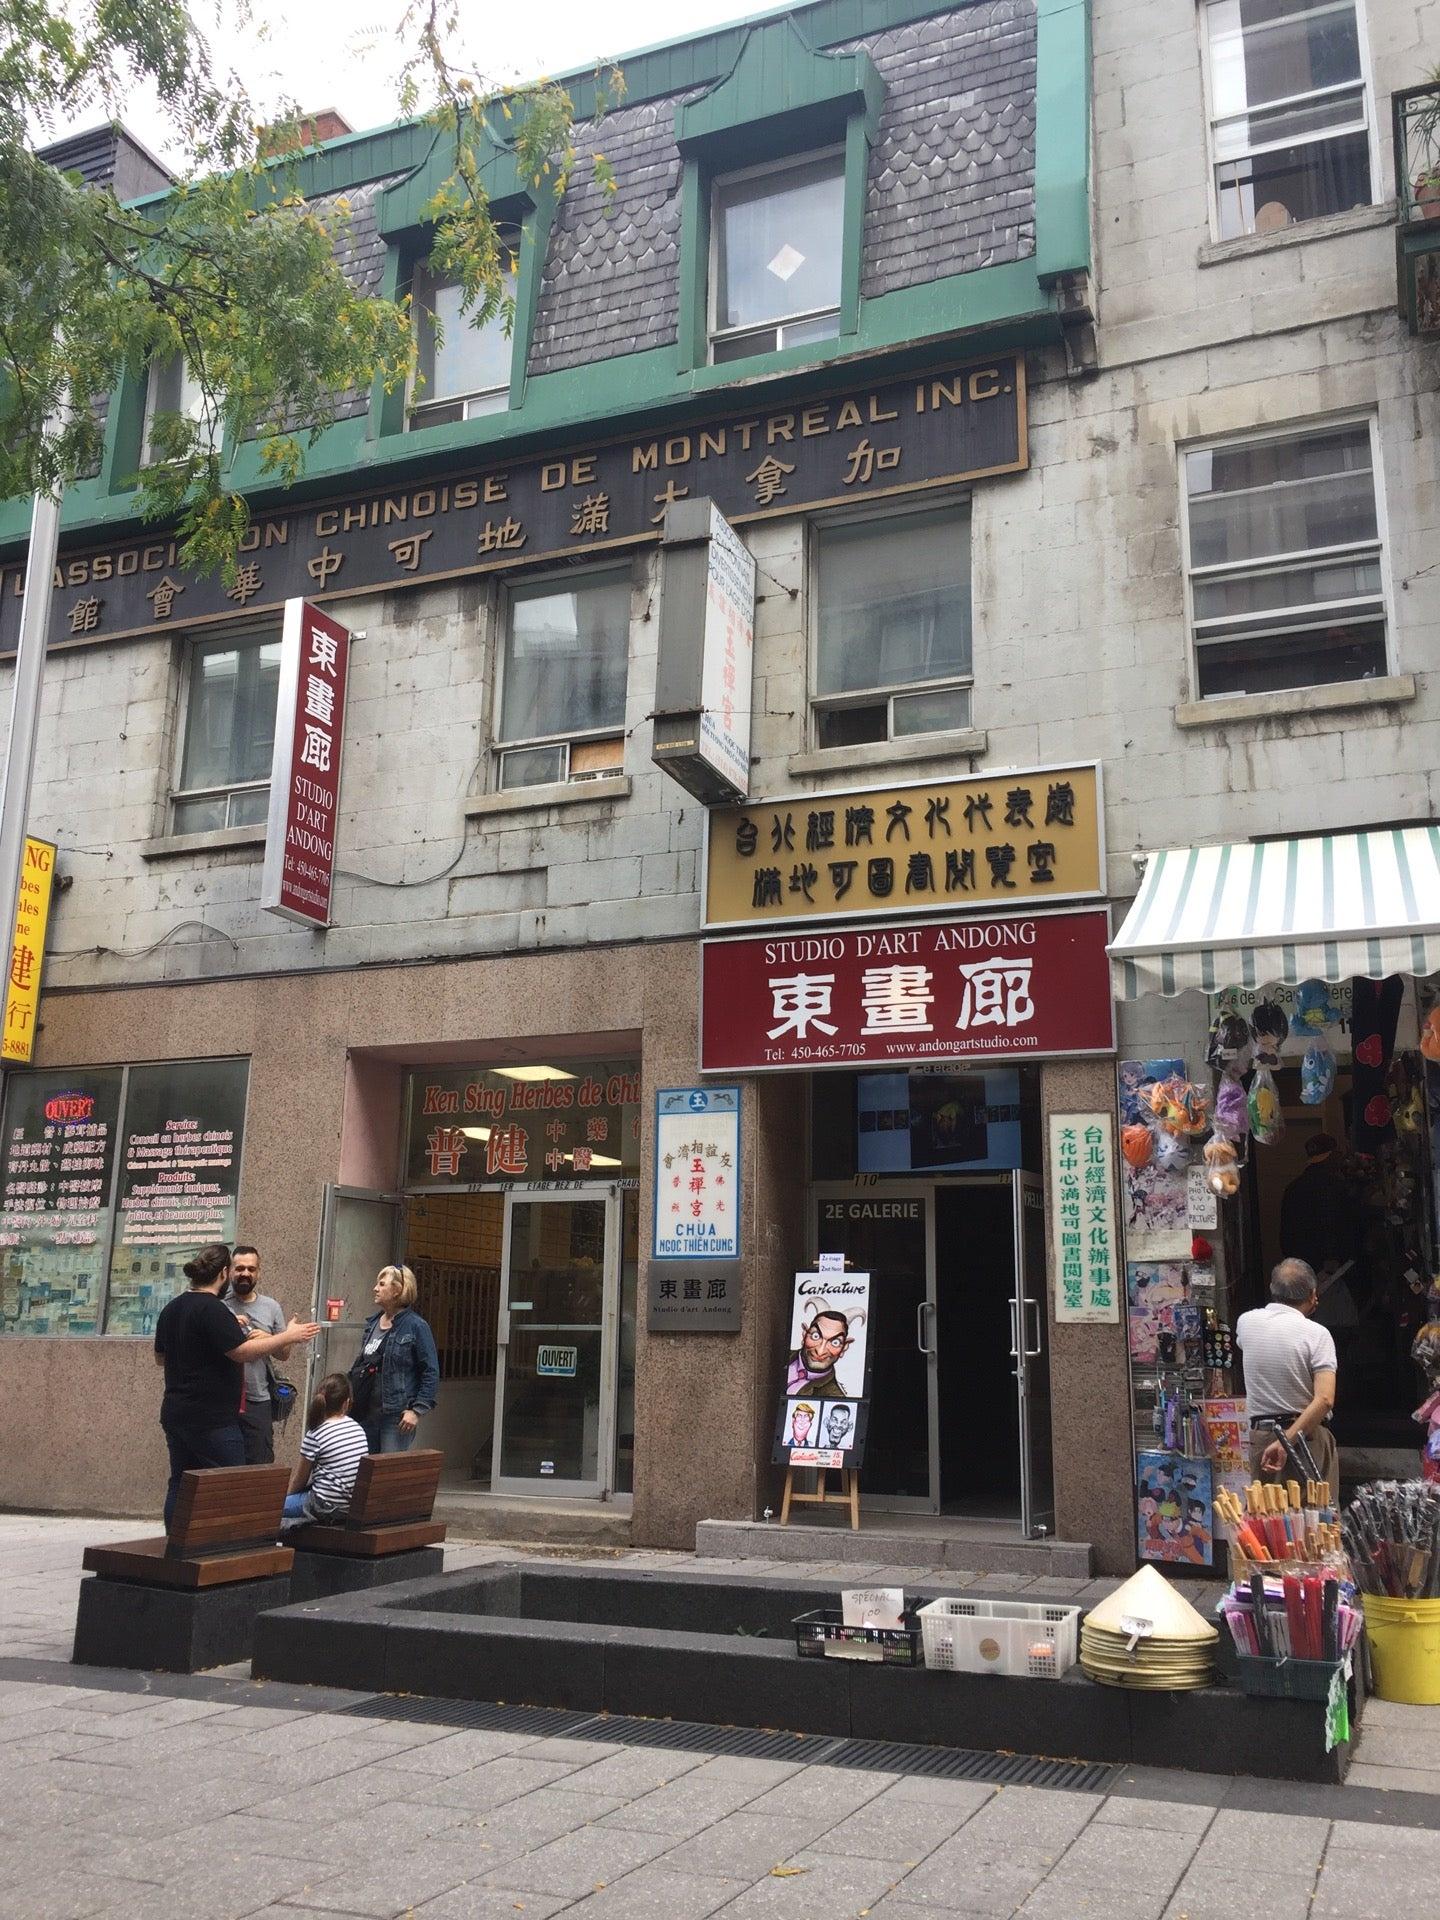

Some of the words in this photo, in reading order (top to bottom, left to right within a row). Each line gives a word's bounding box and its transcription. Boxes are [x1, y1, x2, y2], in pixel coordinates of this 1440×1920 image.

[315, 474, 509, 537] CHINOISE
[540, 456, 597, 492] DE
[915, 368, 1013, 413] INC.
[300, 625, 338, 773] 東畫廊
[294, 775, 333, 810] STUDIO
[297, 801, 328, 833] D'ART
[287, 823, 332, 862] ANDONG
[765, 937, 845, 965] STUDIO
[857, 931, 922, 958] D'ART
[934, 922, 1037, 952] ANDONG
[766, 956, 1036, 1040] 東畫廊
[1240, 990, 1255, 1005] de
[764, 1048, 785, 1061] Tel:
[791, 1042, 867, 1060] 450-465-7705
[886, 1035, 1038, 1055] www.andongartstudio.com
[423, 1086, 459, 1114] Ken
[463, 1082, 506, 1119] Sing
[509, 1079, 574, 1111] Herbes
[578, 1077, 602, 1108] de
[45, 1098, 94, 1119] OUVERT
[165, 1119, 198, 1131] Service:
[129, 1133, 159, 1145] Conseil
[172, 1132, 201, 1143] herbes
[203, 1130, 233, 1142] chinois
[136, 1146, 173, 1159] Massage
[425, 1123, 529, 1176] 普健
[158, 1171, 196, 1183] Produits:
[467, 1183, 482, 1192] 112
[499, 1182, 514, 1191] 1ER
[554, 1181, 571, 1190] REZ
[573, 1180, 584, 1190] DE
[854, 1174, 878, 1187] 110
[825, 1204, 844, 1219] 2E
[848, 1202, 919, 1219] GALERIE
[710, 1238, 733, 1252] CUNG
[659, 1278, 727, 1300] 東畫廊
[798, 1279, 866, 1296] Caricature
[702, 1306, 731, 1314] Andong
[542, 1349, 574, 1367] OUVERT
